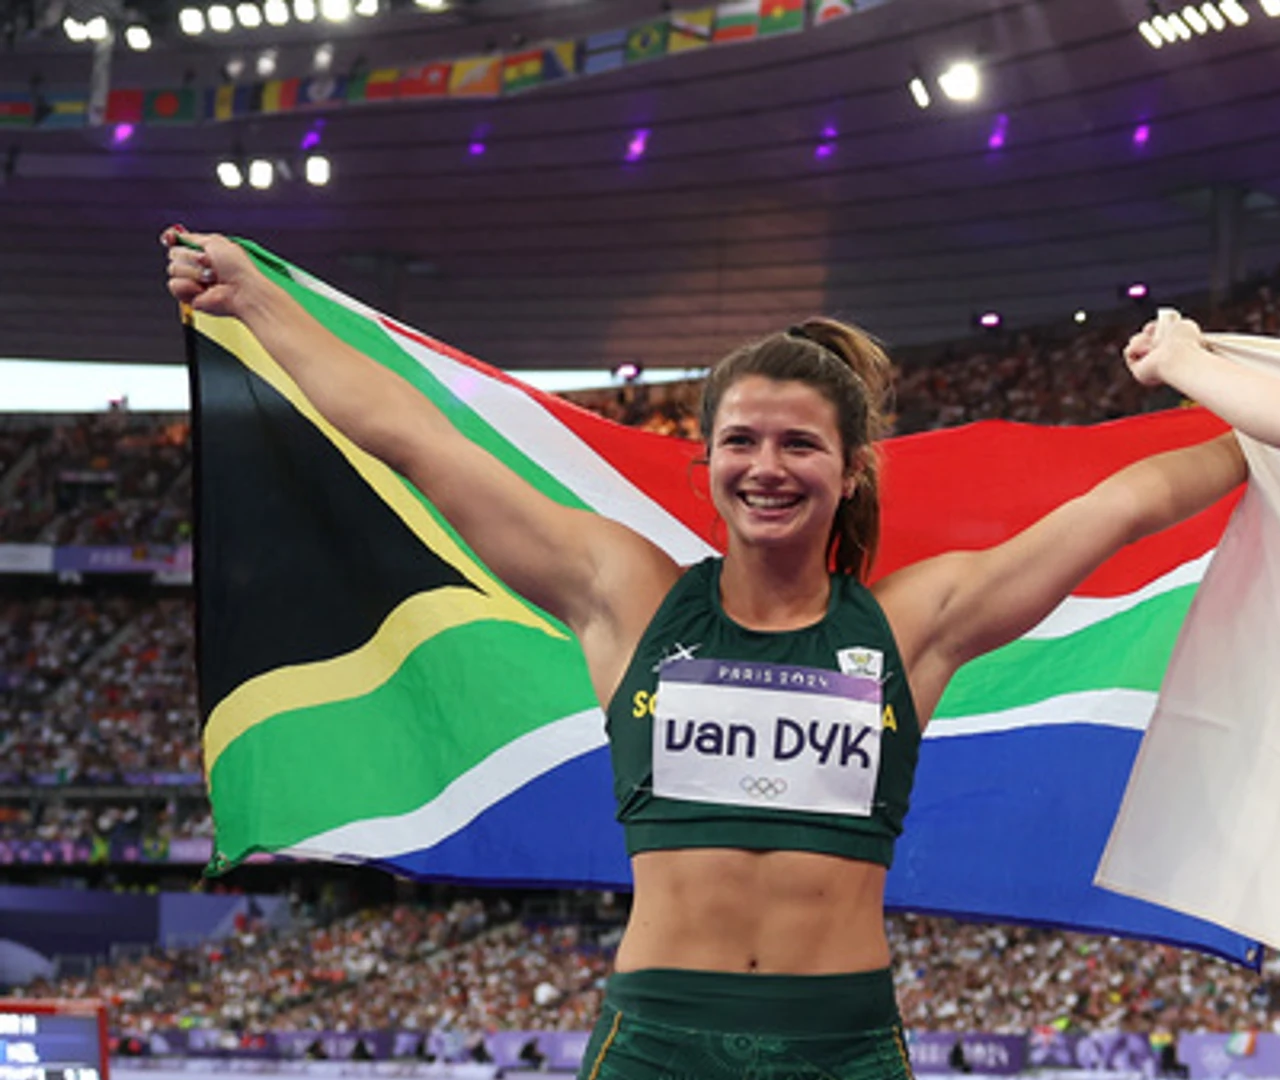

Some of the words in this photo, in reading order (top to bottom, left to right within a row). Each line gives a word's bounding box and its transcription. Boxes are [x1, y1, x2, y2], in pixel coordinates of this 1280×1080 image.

[718, 666, 772, 683] PARIS
[780, 671, 829, 687] 2024
[774, 719, 874, 769] DYK
